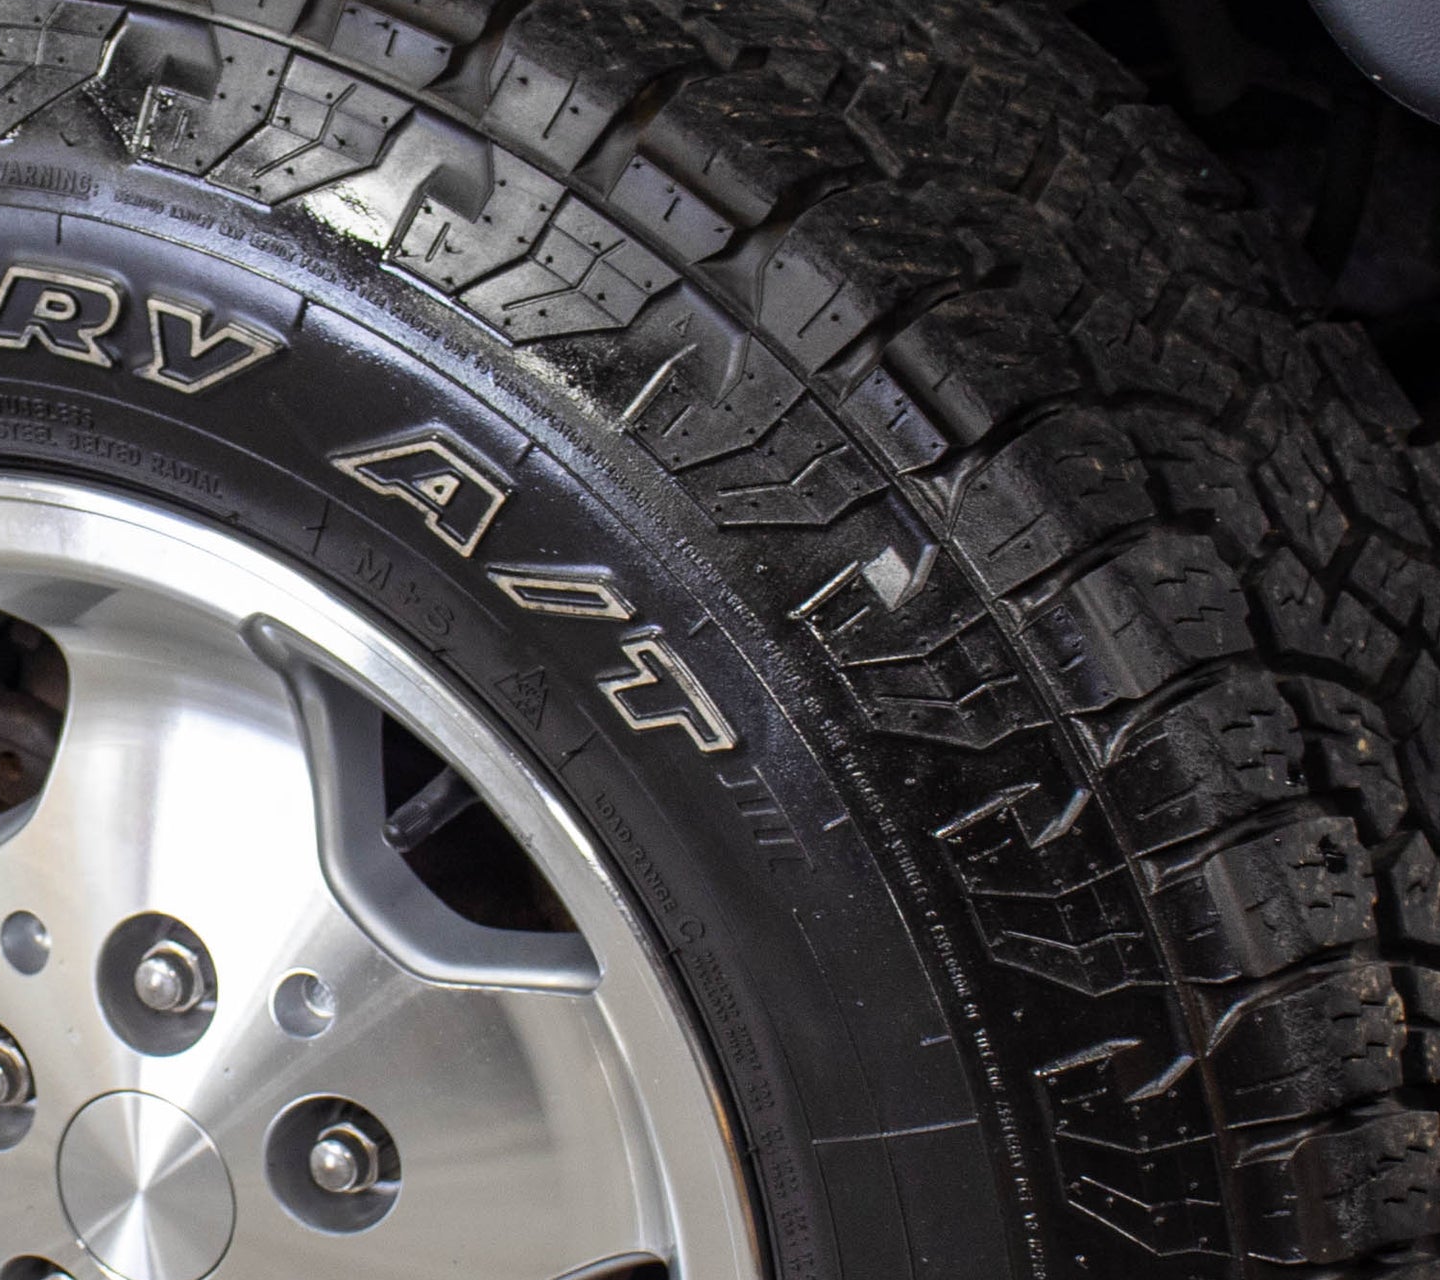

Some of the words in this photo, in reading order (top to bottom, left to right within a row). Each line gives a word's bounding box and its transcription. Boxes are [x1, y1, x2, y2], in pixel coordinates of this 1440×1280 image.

[149, 450, 226, 501] RADIAL
[329, 422, 739, 755] A/T
[589, 788, 637, 846] LOAD
[628, 843, 679, 914] RANGE
